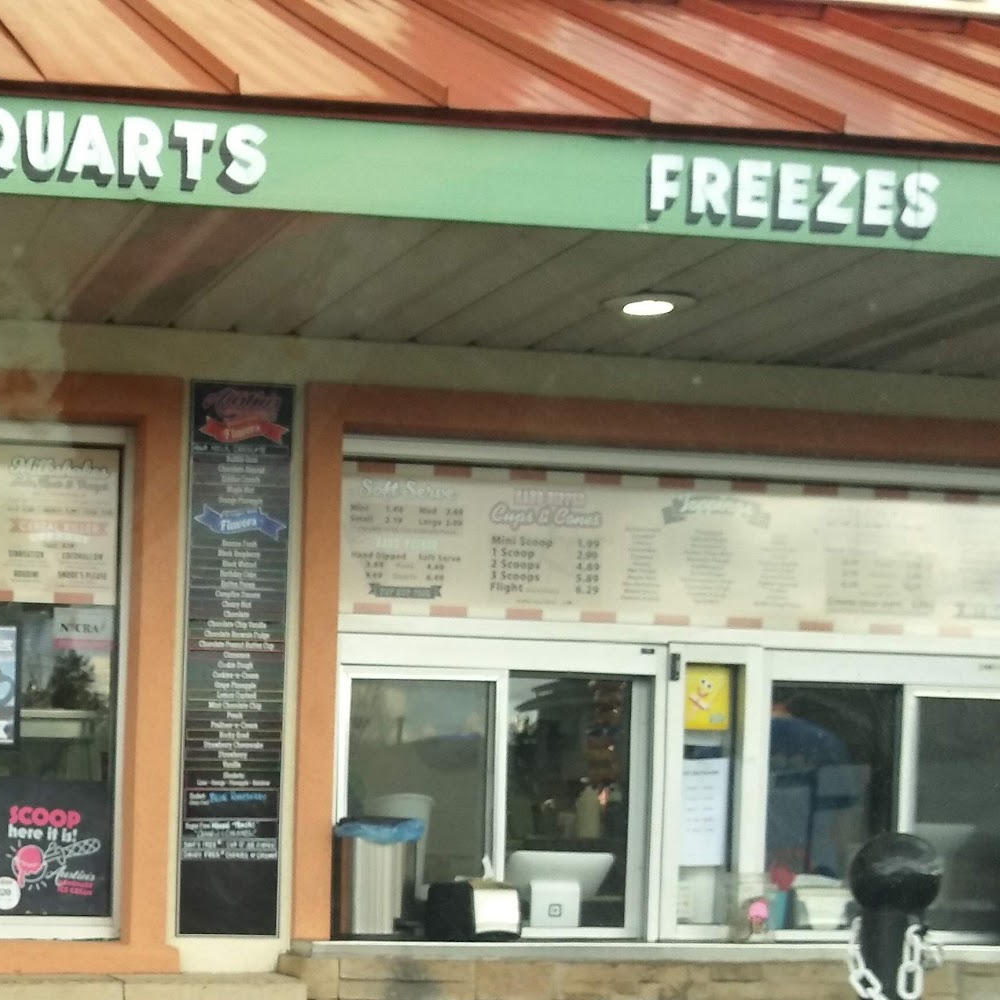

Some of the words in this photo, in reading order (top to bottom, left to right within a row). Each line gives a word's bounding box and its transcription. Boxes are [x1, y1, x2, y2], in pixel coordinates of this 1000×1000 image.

[646, 153, 940, 240] FREEZES
[492, 536, 516, 544] Mini
[520, 536, 552, 549] Scoop
[501, 547, 535, 559] Scoop
[501, 559, 540, 571] Scoops
[501, 571, 540, 583] Scoops
[490, 582, 523, 594] Flight
[9, 805, 82, 829] SCOOP
[8, 824, 43, 839] here
[47, 826, 58, 841] it
[61, 828, 78, 842] is!
[45, 865, 95, 886] Austin's
